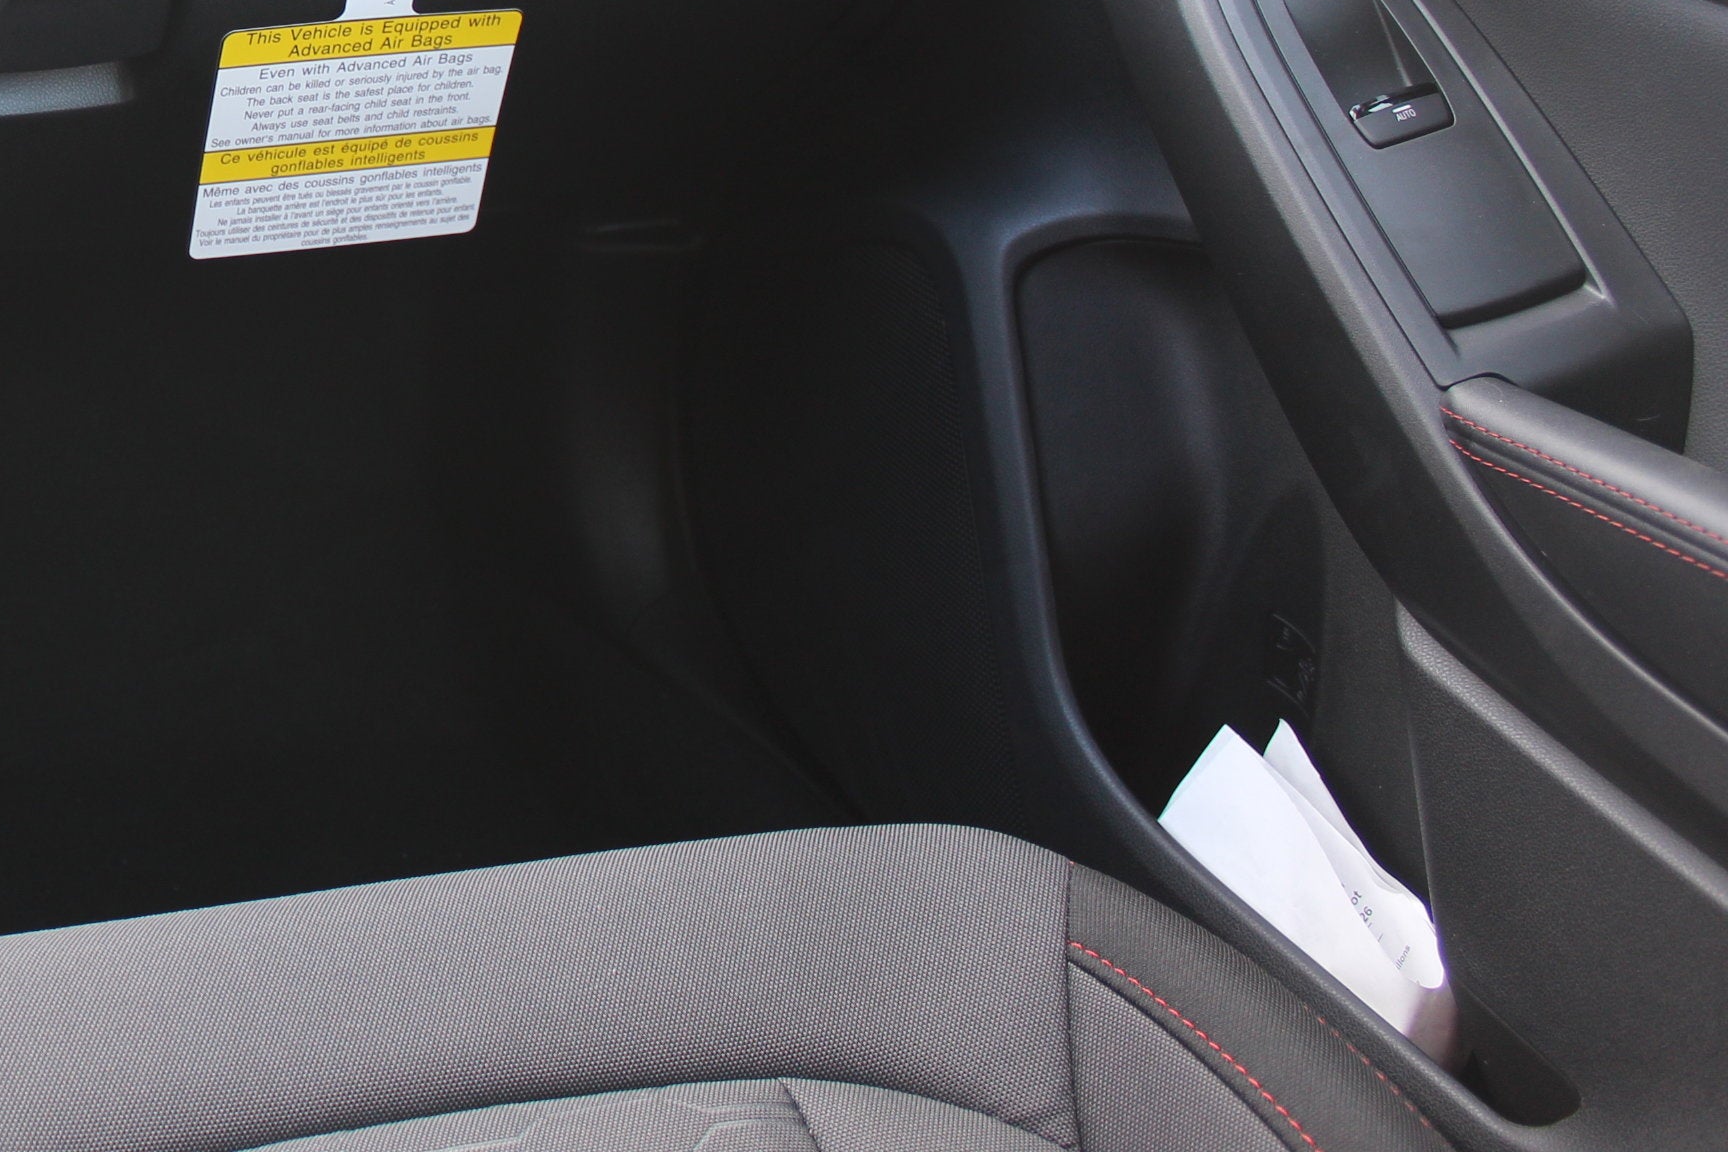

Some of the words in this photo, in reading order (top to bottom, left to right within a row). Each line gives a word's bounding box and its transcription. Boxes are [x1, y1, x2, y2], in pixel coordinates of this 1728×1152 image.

[247, 31, 282, 45] This
[290, 25, 352, 41] Vehicle
[359, 23, 374, 36] is
[381, 16, 462, 35] Equipped
[468, 14, 501, 27] with
[288, 38, 373, 58] Advanced
[380, 36, 403, 50] Air
[410, 34, 453, 48] Bags
[259, 68, 295, 80] Even
[302, 63, 330, 76] with
[336, 56, 407, 73] Advanced
[412, 54, 433, 66] Air
[437, 52, 473, 65] Bags
[220, 85, 262, 96] Children
[265, 84, 284, 92] can
[288, 81, 301, 90] be
[305, 78, 331, 89] killed
[334, 78, 345, 87] or
[348, 73, 392, 86] seriously
[395, 70, 429, 83] injured
[431, 69, 444, 80] by
[447, 68, 463, 77] the
[466, 66, 480, 76] air
[243, 110, 274, 120] Never
[277, 107, 294, 119] put
[308, 102, 361, 114] rear-facing
[364, 98, 388, 109] child
[390, 96, 412, 107] seat
[414, 96, 424, 105] in
[428, 94, 444, 104] the
[247, 97, 266, 107] The
[269, 94, 293, 105] back
[297, 92, 319, 102] seat
[322, 91, 331, 100] is
[334, 90, 351, 99] the
[353, 86, 384, 98] safest
[386, 85, 414, 97] place
[417, 83, 431, 92] for
[250, 121, 286, 132] Always
[290, 119, 309, 128] use
[312, 116, 334, 126] seat
[337, 114, 361, 124] belts
[364, 111, 384, 122] and
[386, 108, 410, 120] child
[1395, 108, 1417, 122] AUTO
[210, 138, 231, 148] See
[234, 134, 274, 145] owner's
[277, 129, 315, 142] manual
[317, 129, 332, 138] for
[334, 127, 360, 136] more
[363, 121, 417, 134] information
[420, 118, 448, 129] about
[450, 116, 464, 126] air
[220, 153, 241, 164] Ce
[247, 147, 307, 162] véhicule
[312, 144, 335, 156] est
[340, 138, 388, 155] équipé
[394, 137, 412, 148] de
[417, 132, 479, 146] coussins
[270, 157, 344, 176] gonflables
[350, 149, 426, 166] intelligents
[202, 186, 240, 198] Même
[244, 184, 273, 194] avec
[277, 180, 299, 191] des
[304, 175, 355, 188] coussins
[359, 169, 418, 186] gonflables
[422, 163, 482, 177] intelligents
